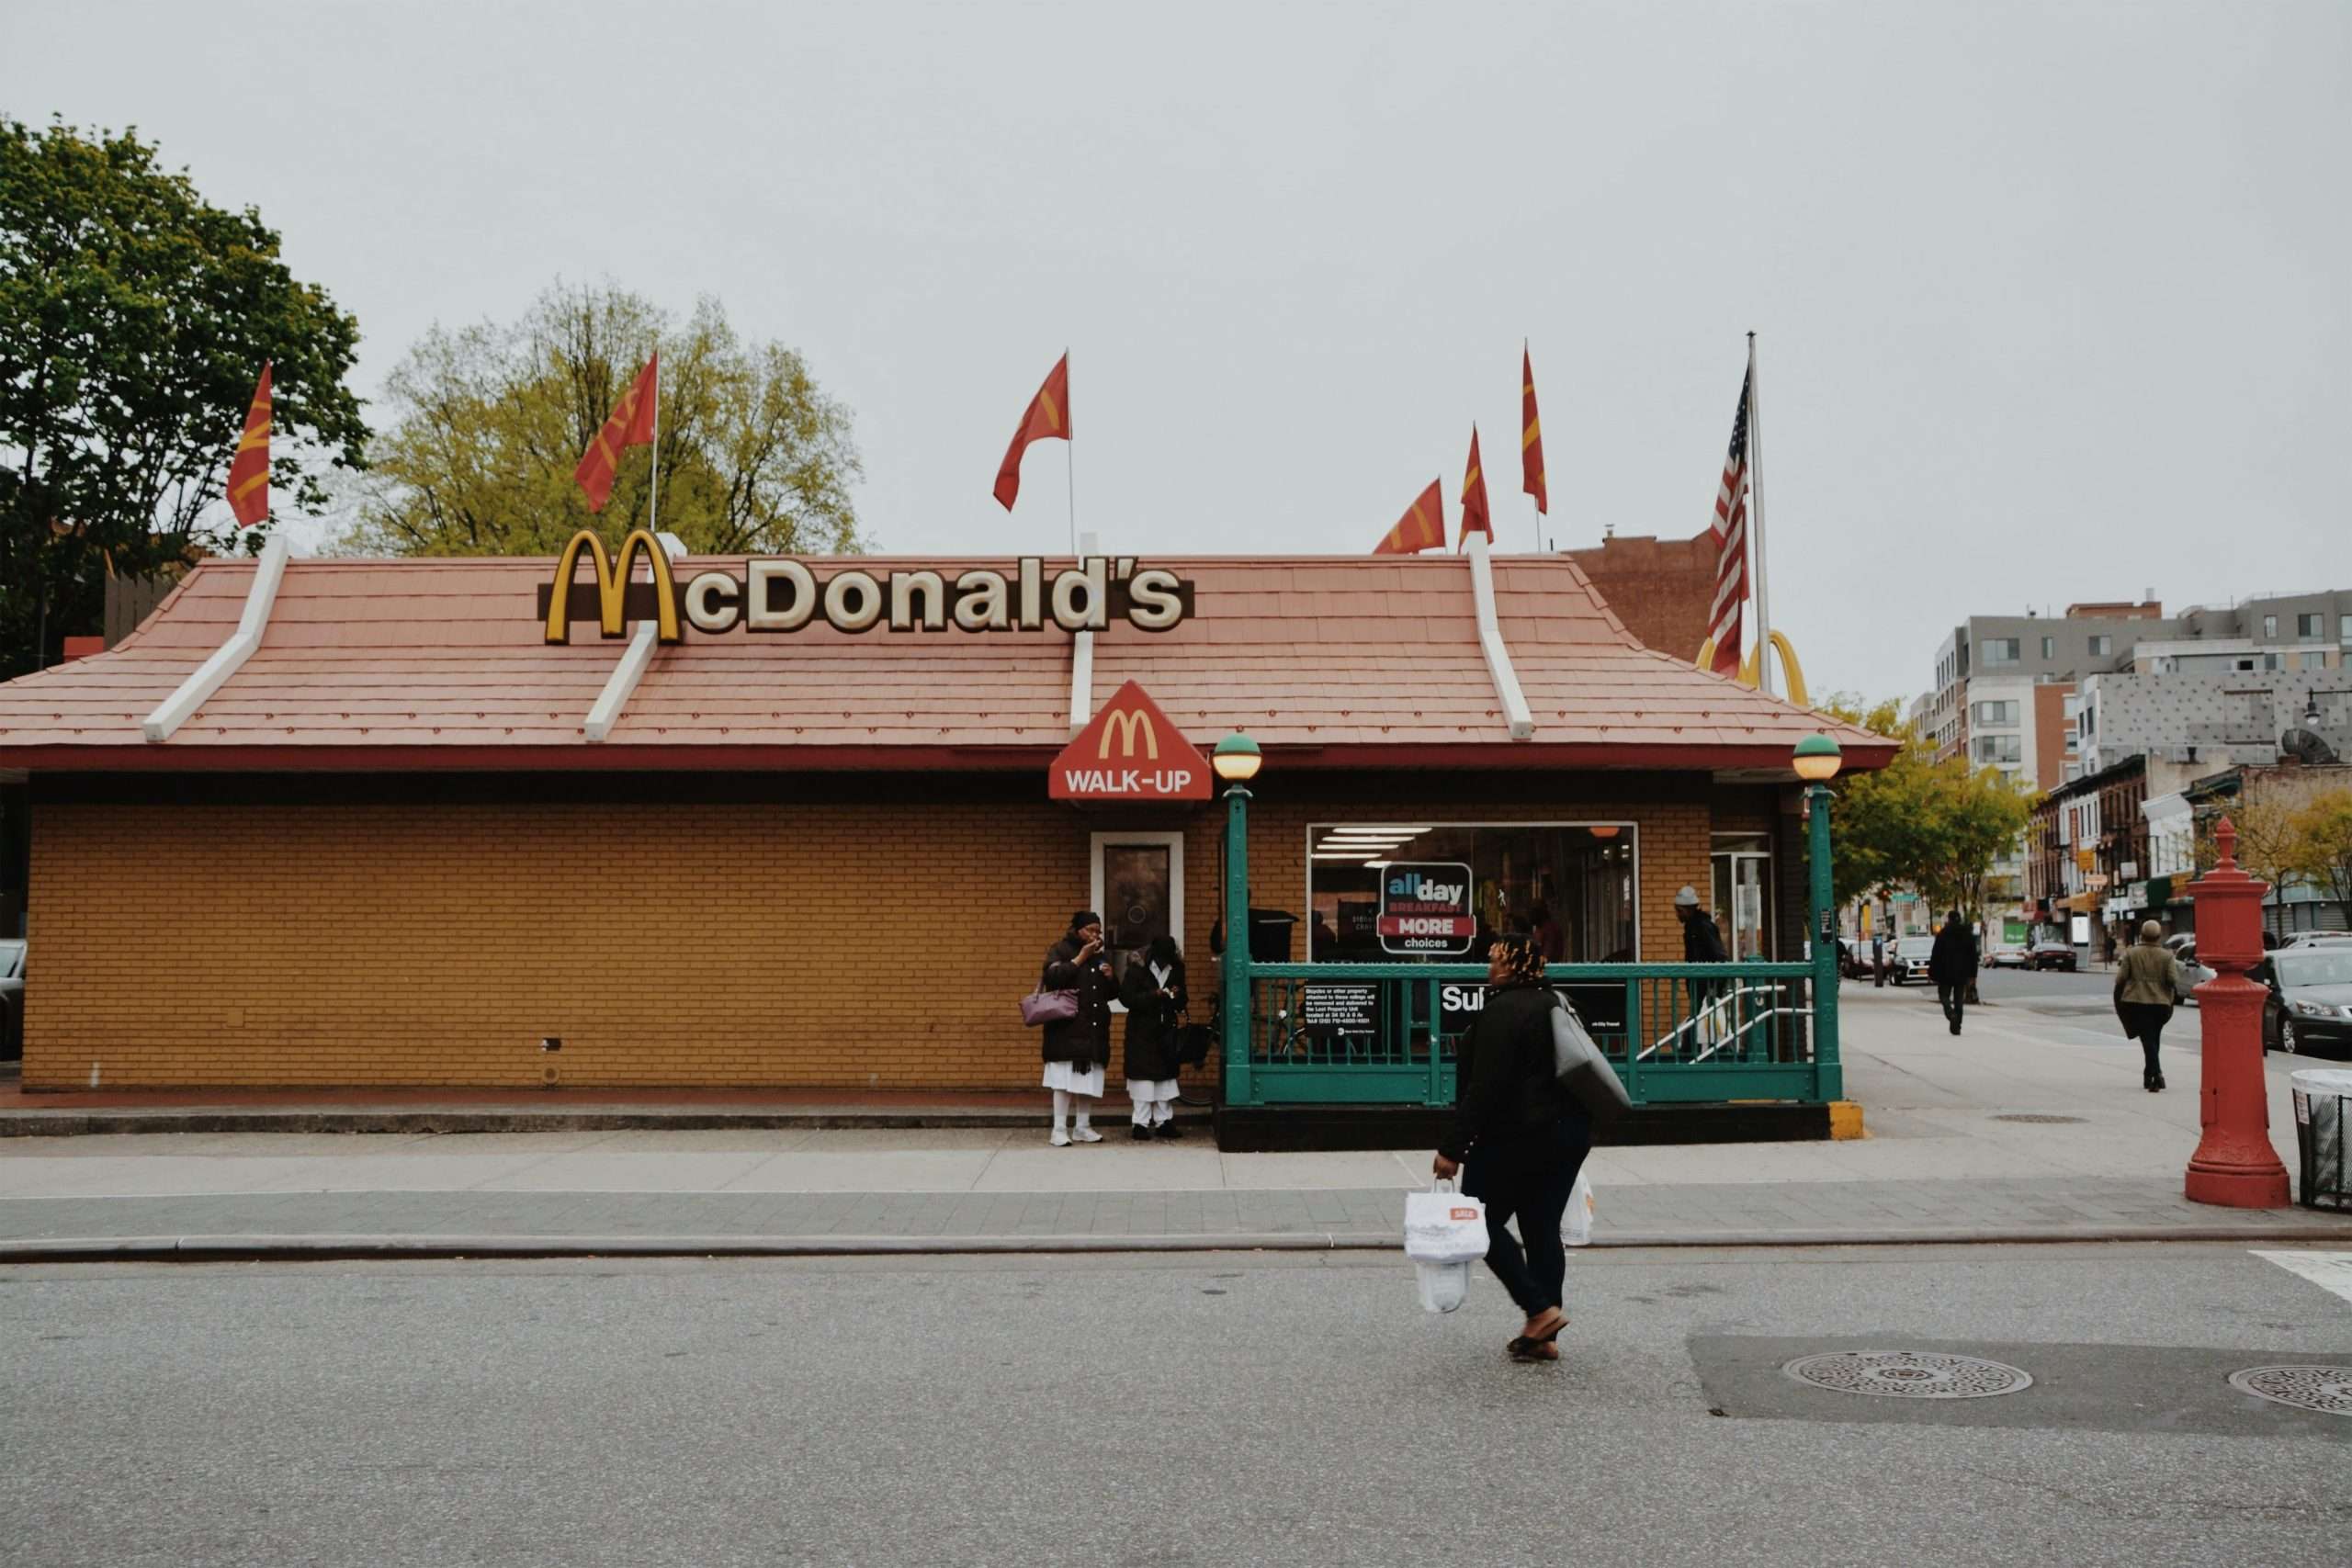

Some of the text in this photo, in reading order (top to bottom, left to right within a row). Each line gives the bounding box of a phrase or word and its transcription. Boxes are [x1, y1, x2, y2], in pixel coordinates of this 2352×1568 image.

[544, 528, 1183, 644] McDonald's
[1065, 770, 1192, 793] WALK-UP
[1388, 902, 1464, 913] BREAKFAST
[1398, 919, 1453, 935] MORE
[1404, 937, 1448, 948] choices
